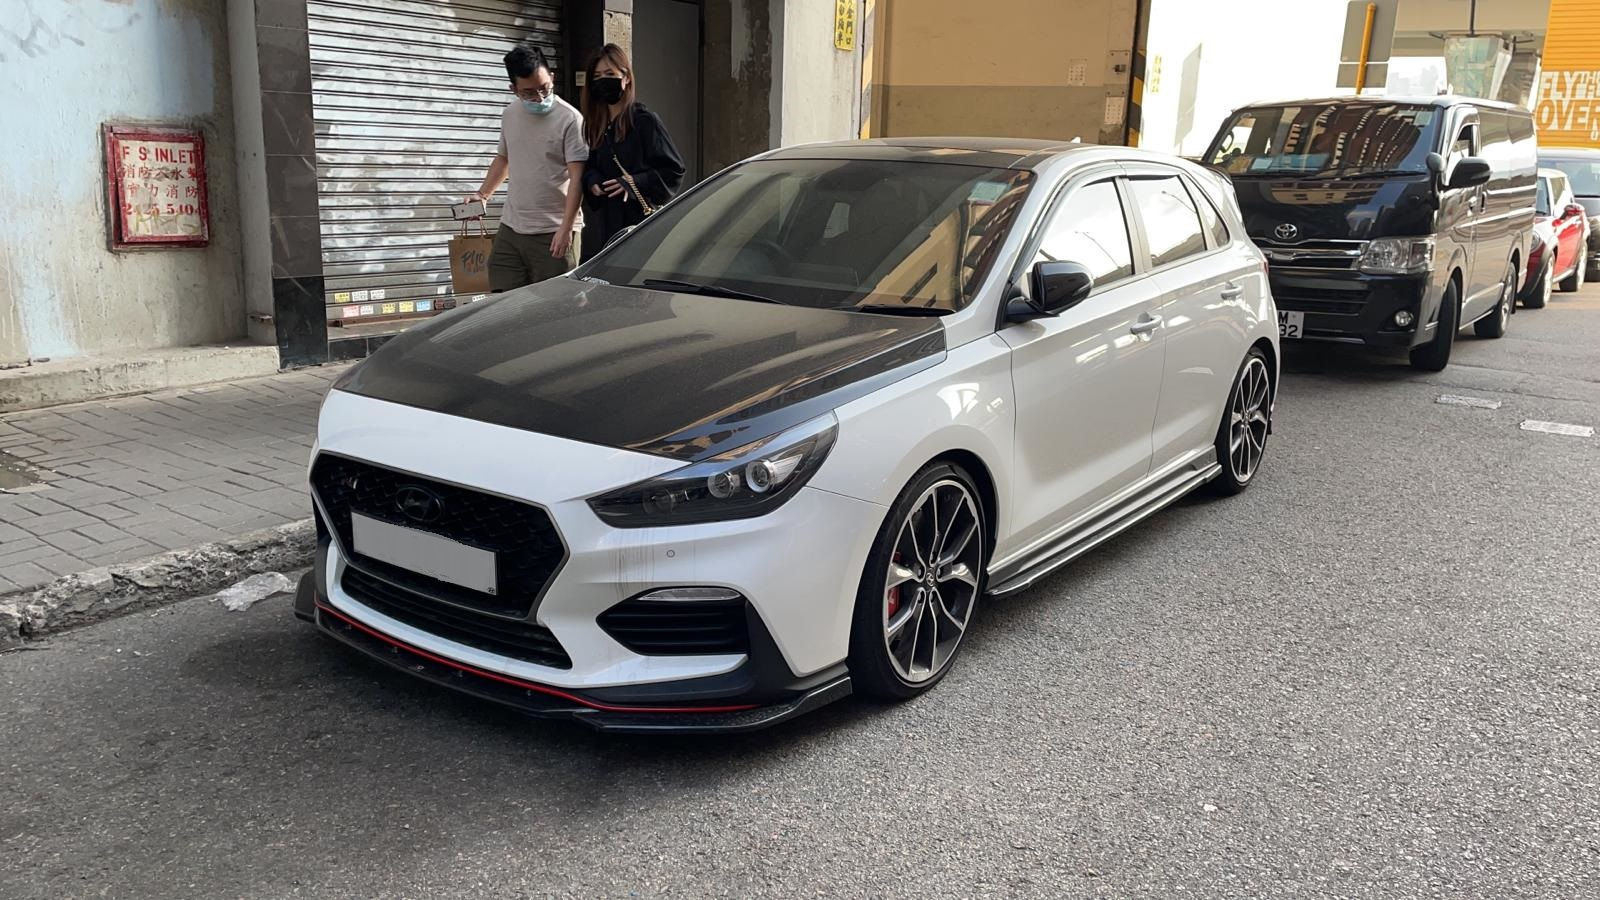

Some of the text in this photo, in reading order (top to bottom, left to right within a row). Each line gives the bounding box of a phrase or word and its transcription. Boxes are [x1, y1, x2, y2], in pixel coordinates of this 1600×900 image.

[1538, 71, 1577, 99] FLY
[1536, 99, 1600, 131] OVER
[122, 146, 195, 163] F S INLET
[1278, 311, 1289, 325] M
